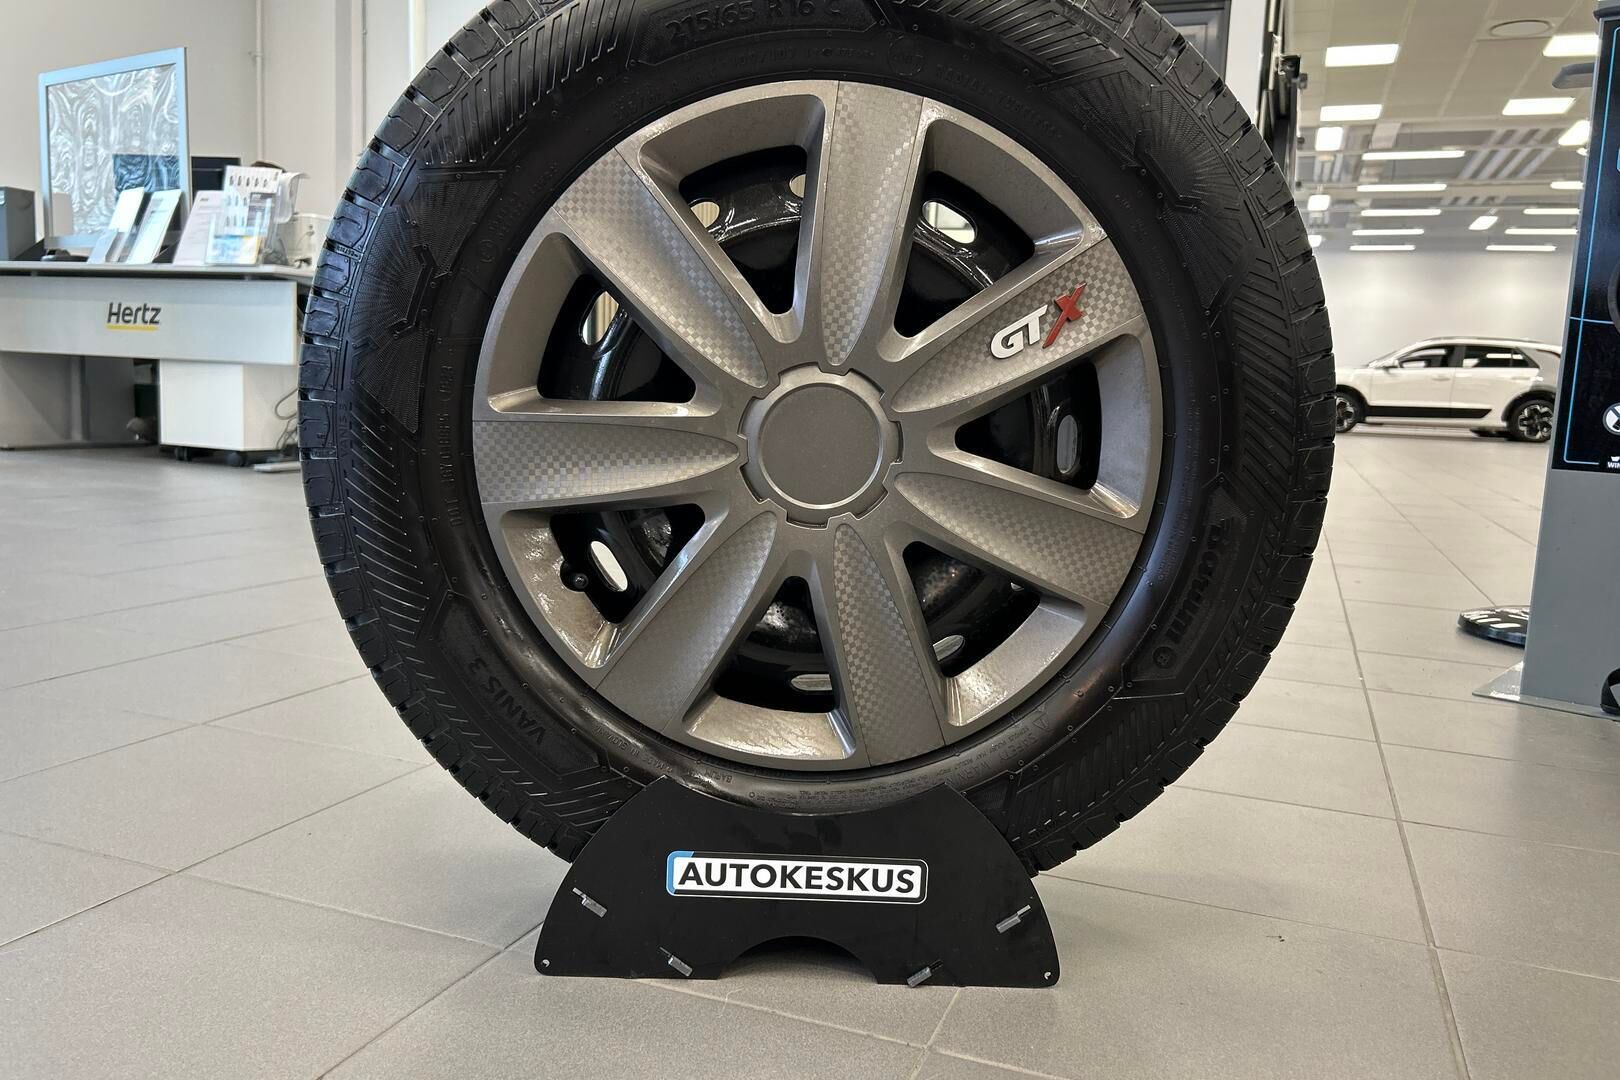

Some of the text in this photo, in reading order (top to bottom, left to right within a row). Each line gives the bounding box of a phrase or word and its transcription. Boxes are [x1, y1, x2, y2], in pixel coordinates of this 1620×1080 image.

[664, 0, 754, 41] 215/65
[107, 301, 161, 325] Hertz
[990, 282, 1087, 359] GTX
[468, 657, 546, 745] VANIS 3
[678, 862, 915, 893] AUTOKESKUS
